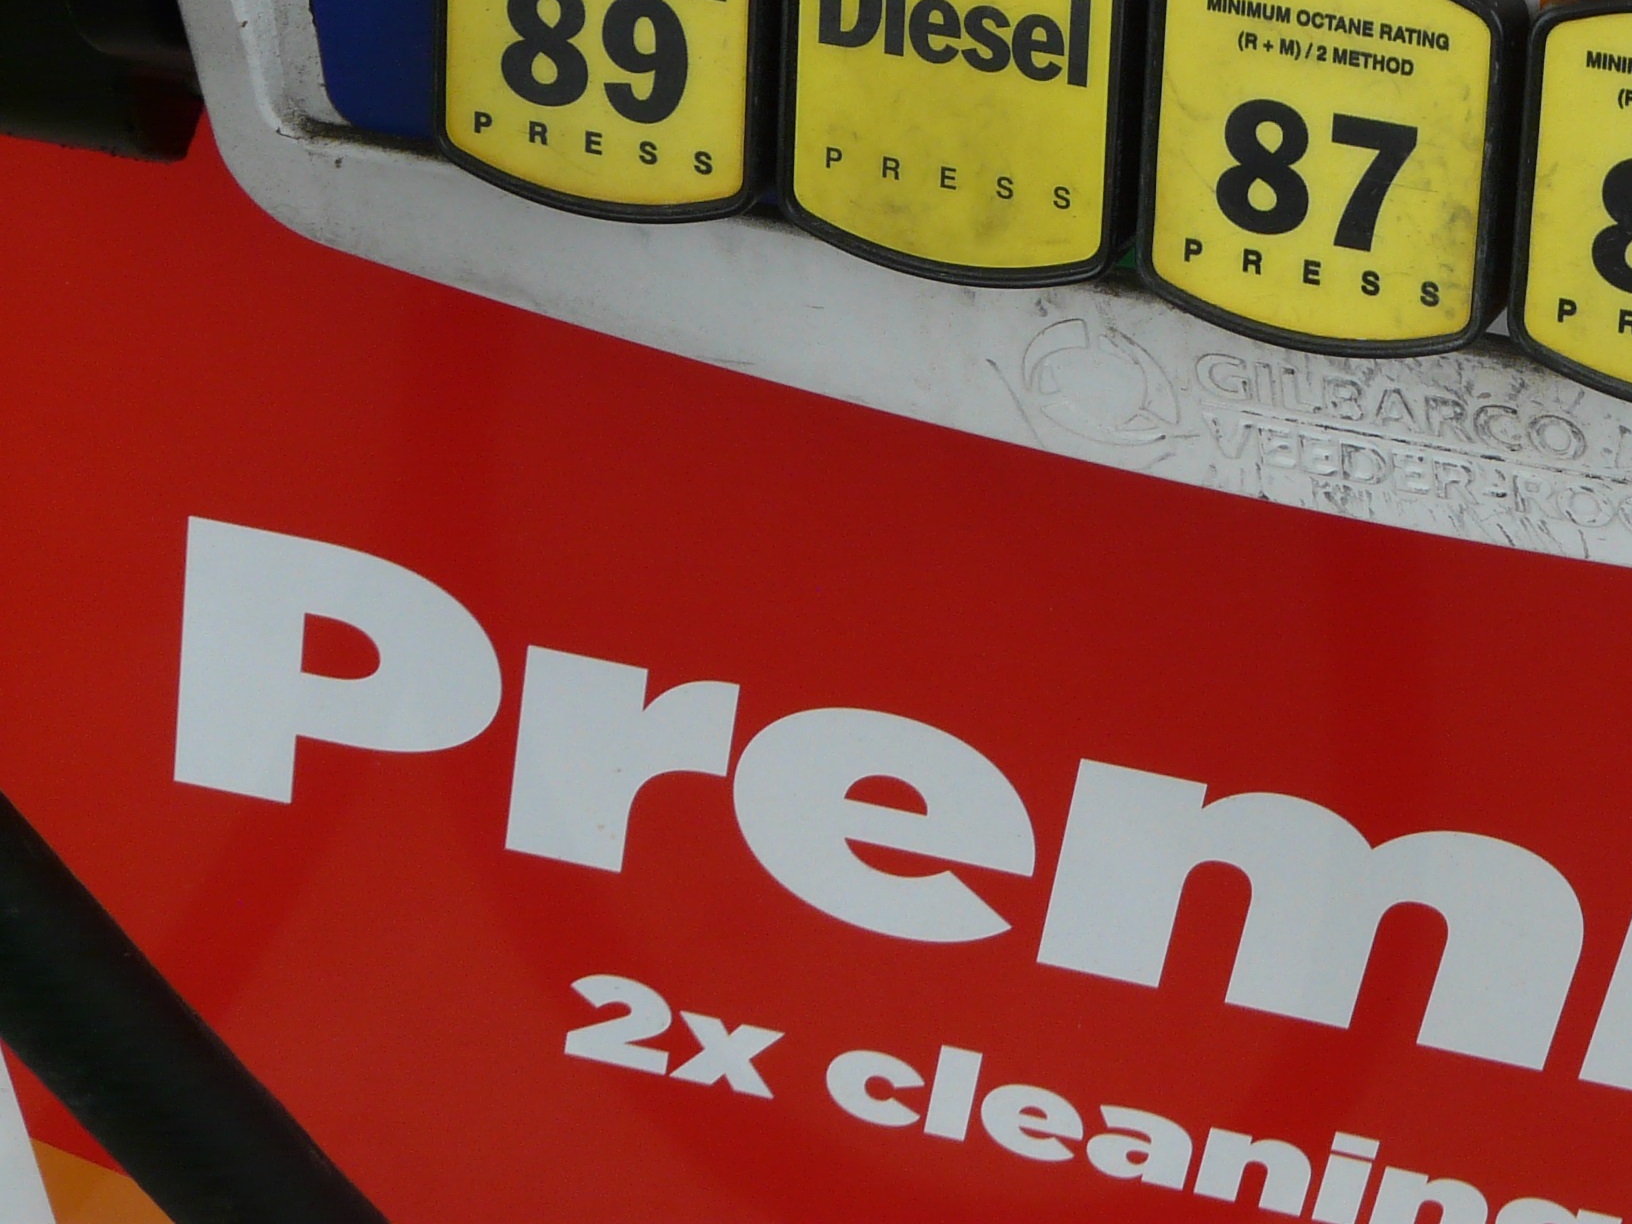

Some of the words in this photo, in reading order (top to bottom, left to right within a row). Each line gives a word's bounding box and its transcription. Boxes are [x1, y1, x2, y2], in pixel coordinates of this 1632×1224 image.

[1296, 9, 1374, 38] OCTANE
[1379, 23, 1450, 52] RATING
[1316, 44, 1327, 62] 2
[1332, 48, 1414, 77] METHOD
[1216, 98, 1418, 253] 87
[1195, 352, 1587, 460] GILBARCO
[564, 974, 786, 1099] 2x
[825, 1044, 1624, 1224] cleanin
